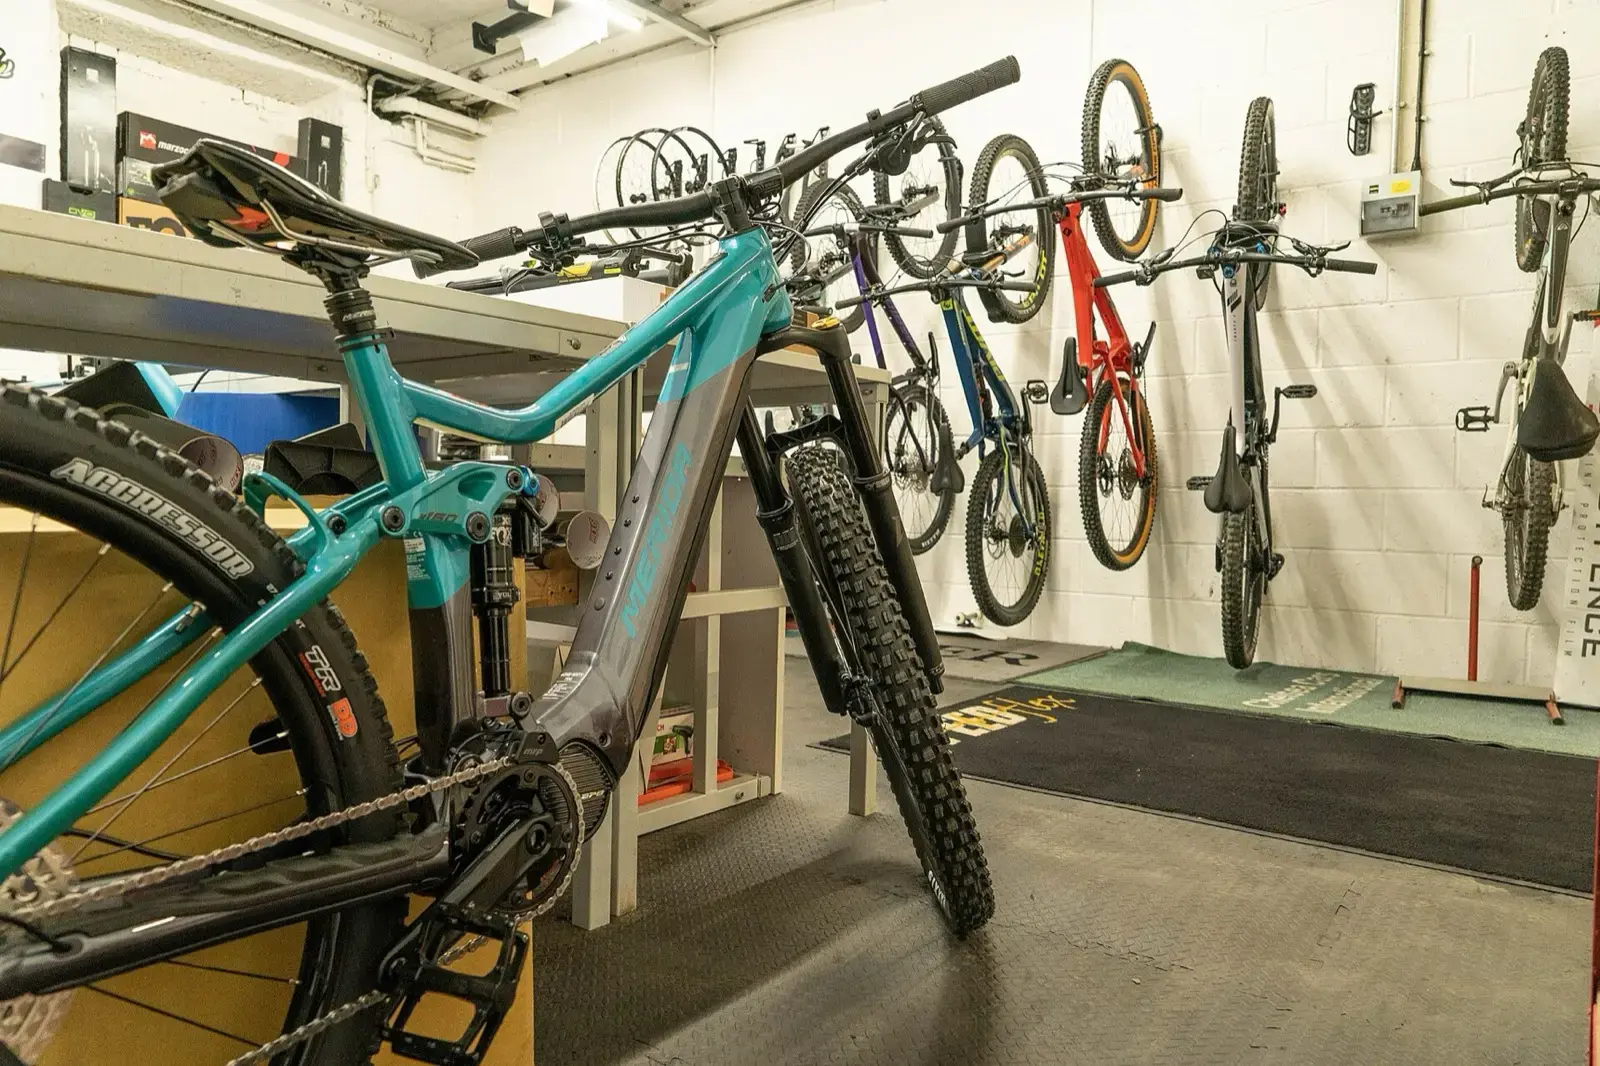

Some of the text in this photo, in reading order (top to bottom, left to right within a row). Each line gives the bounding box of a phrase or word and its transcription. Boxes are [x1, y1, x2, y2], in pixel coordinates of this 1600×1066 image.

[157, 140, 191, 155] marzoc
[50, 457, 255, 580] AGGRESSOR
[620, 441, 692, 640] MERIDA
[1569, 502, 1589, 606] PROTECTION
[1563, 619, 1576, 656] FILM
